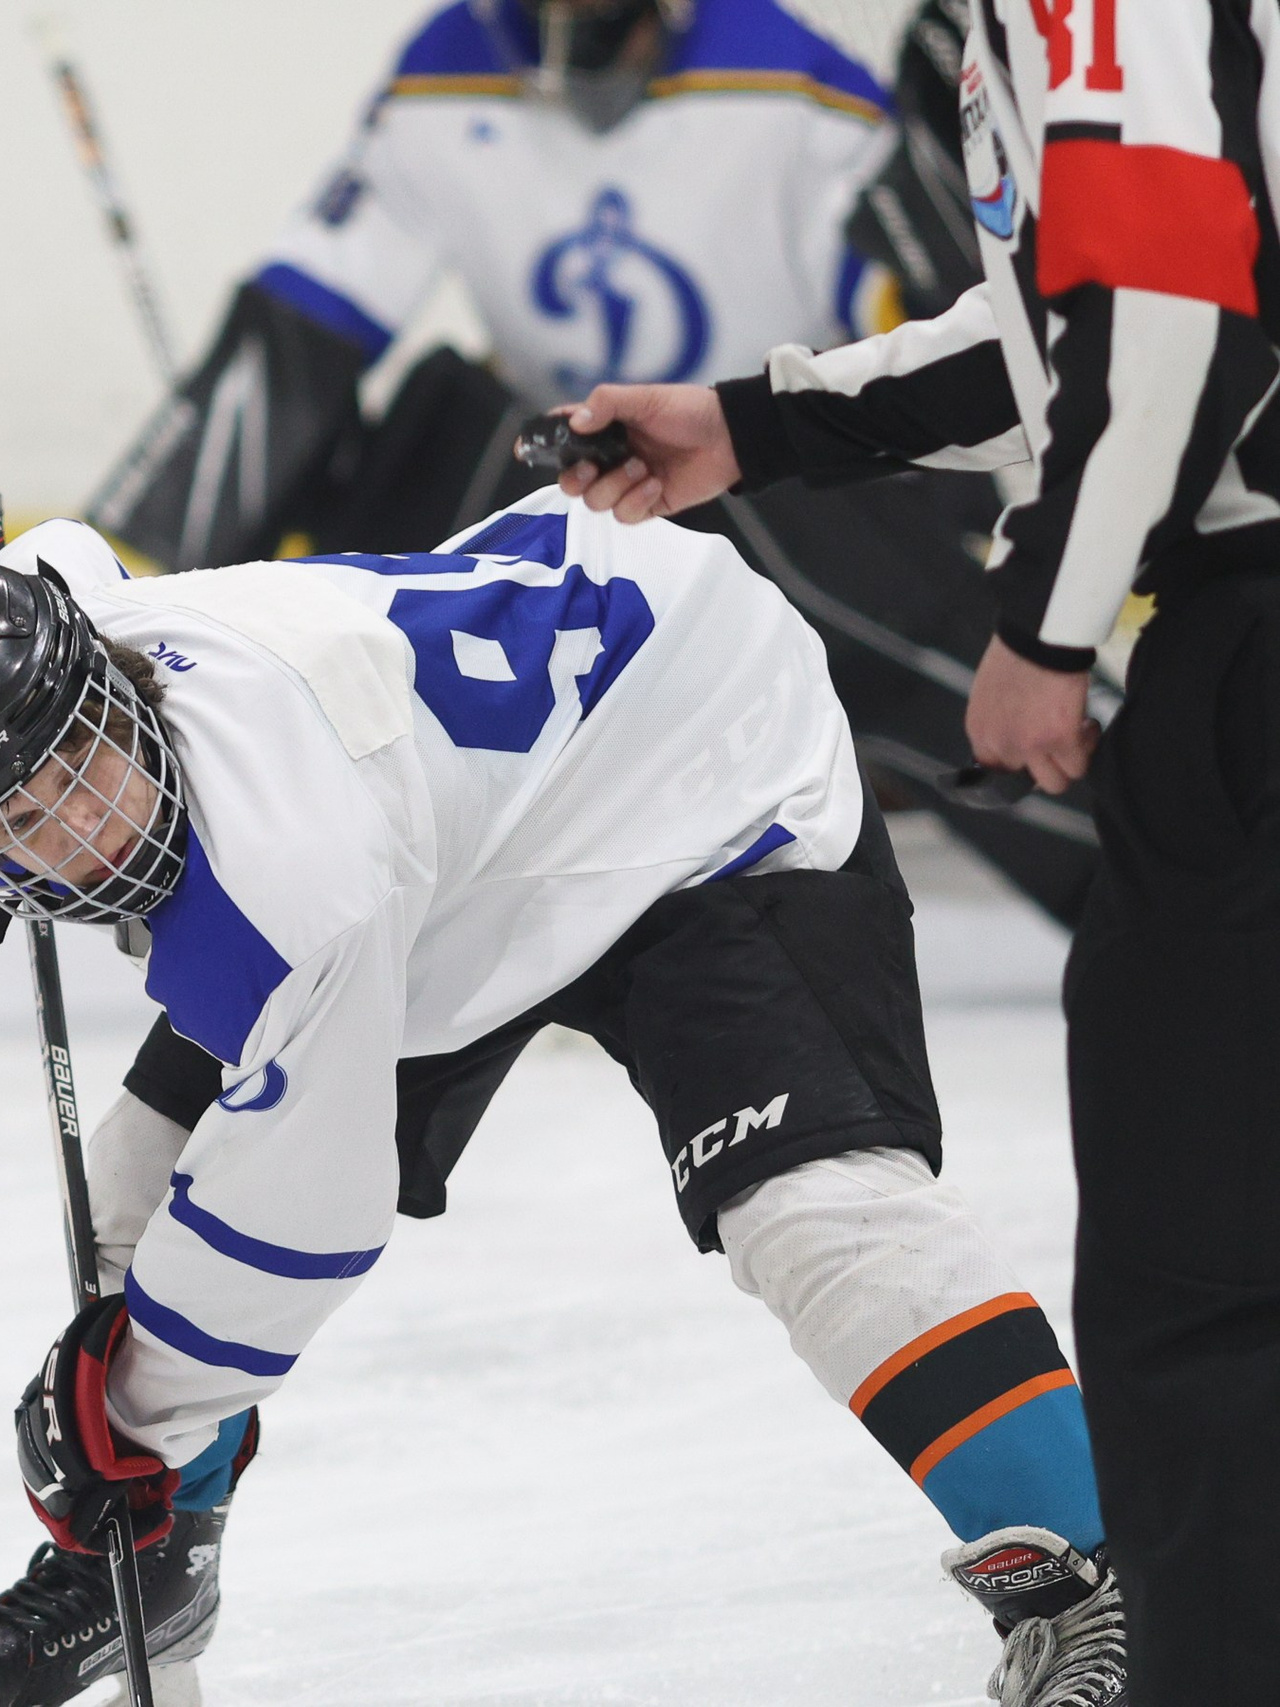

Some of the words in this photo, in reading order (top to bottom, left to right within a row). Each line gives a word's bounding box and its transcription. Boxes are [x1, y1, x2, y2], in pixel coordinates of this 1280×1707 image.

[50, 1044, 79, 1138] BAUER
[671, 1092, 790, 1194] CCM
[960, 1561, 1063, 1588] VAPOR
[986, 1552, 1033, 1571] BAUER
